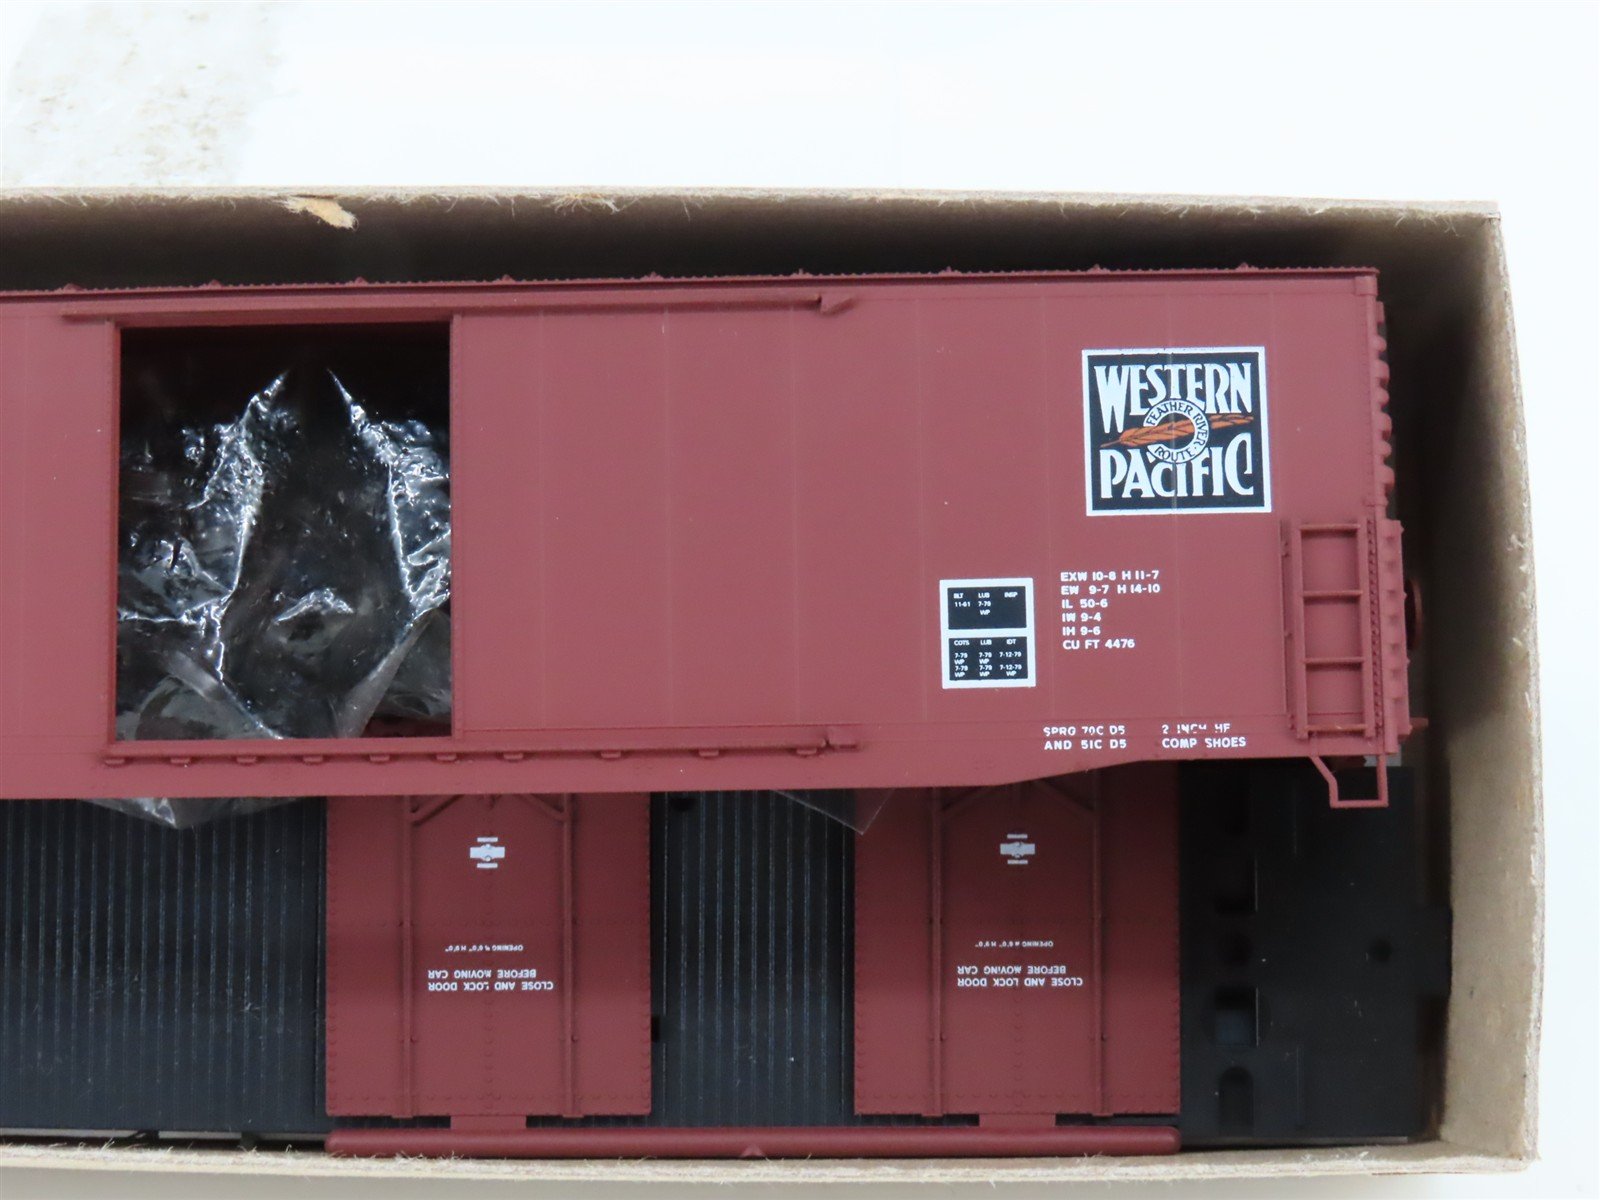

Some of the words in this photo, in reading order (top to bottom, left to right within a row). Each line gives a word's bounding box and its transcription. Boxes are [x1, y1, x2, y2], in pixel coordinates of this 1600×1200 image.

[1094, 362, 1253, 434] WESTERN
[1145, 401, 1193, 426] FEATHER
[1193, 413, 1208, 446] RIVER
[1154, 446, 1195, 461] ROUTE
[1099, 432, 1255, 499] PACIFIC
[1060, 571, 1088, 581] EXW
[1121, 570, 1132, 580] H
[1134, 569, 1160, 580] 11-7
[1060, 585, 1079, 596] EW
[1088, 584, 1110, 595] 9-7
[1116, 583, 1127, 594] H
[1130, 583, 1161, 594] 14-10
[1061, 599, 1074, 609] IL
[1079, 598, 1109, 609] 50-6
[1061, 613, 1076, 622] IW
[1080, 612, 1102, 622] 9-4
[1080, 625, 1101, 636] 9-6
[1062, 639, 1080, 650] CU
[1084, 639, 1100, 650] FT
[1104, 638, 1136, 649] 4476
[1109, 725, 1126, 735] D5
[1161, 724, 1170, 735] 2
[1044, 740, 1073, 751] AND
[1109, 739, 1127, 749] D5
[1161, 737, 1198, 749] COMP
[1204, 736, 1247, 748] SHOES
[1021, 940, 1054, 948] OPENING
[428, 969, 448, 979] CAR
[454, 969, 492, 979] MOVING
[497, 969, 537, 979] BEFORE
[957, 966, 978, 976] CAR
[983, 966, 1022, 976] MOVING
[1027, 965, 1066, 975] BEFORE
[428, 982, 458, 991] DOOR
[494, 981, 516, 991] AND
[521, 981, 554, 991] CLOSE
[957, 978, 988, 987] DOOR
[992, 978, 1019, 987] LOCK
[1024, 977, 1046, 987] AND
[1051, 977, 1083, 987] CLOSE
